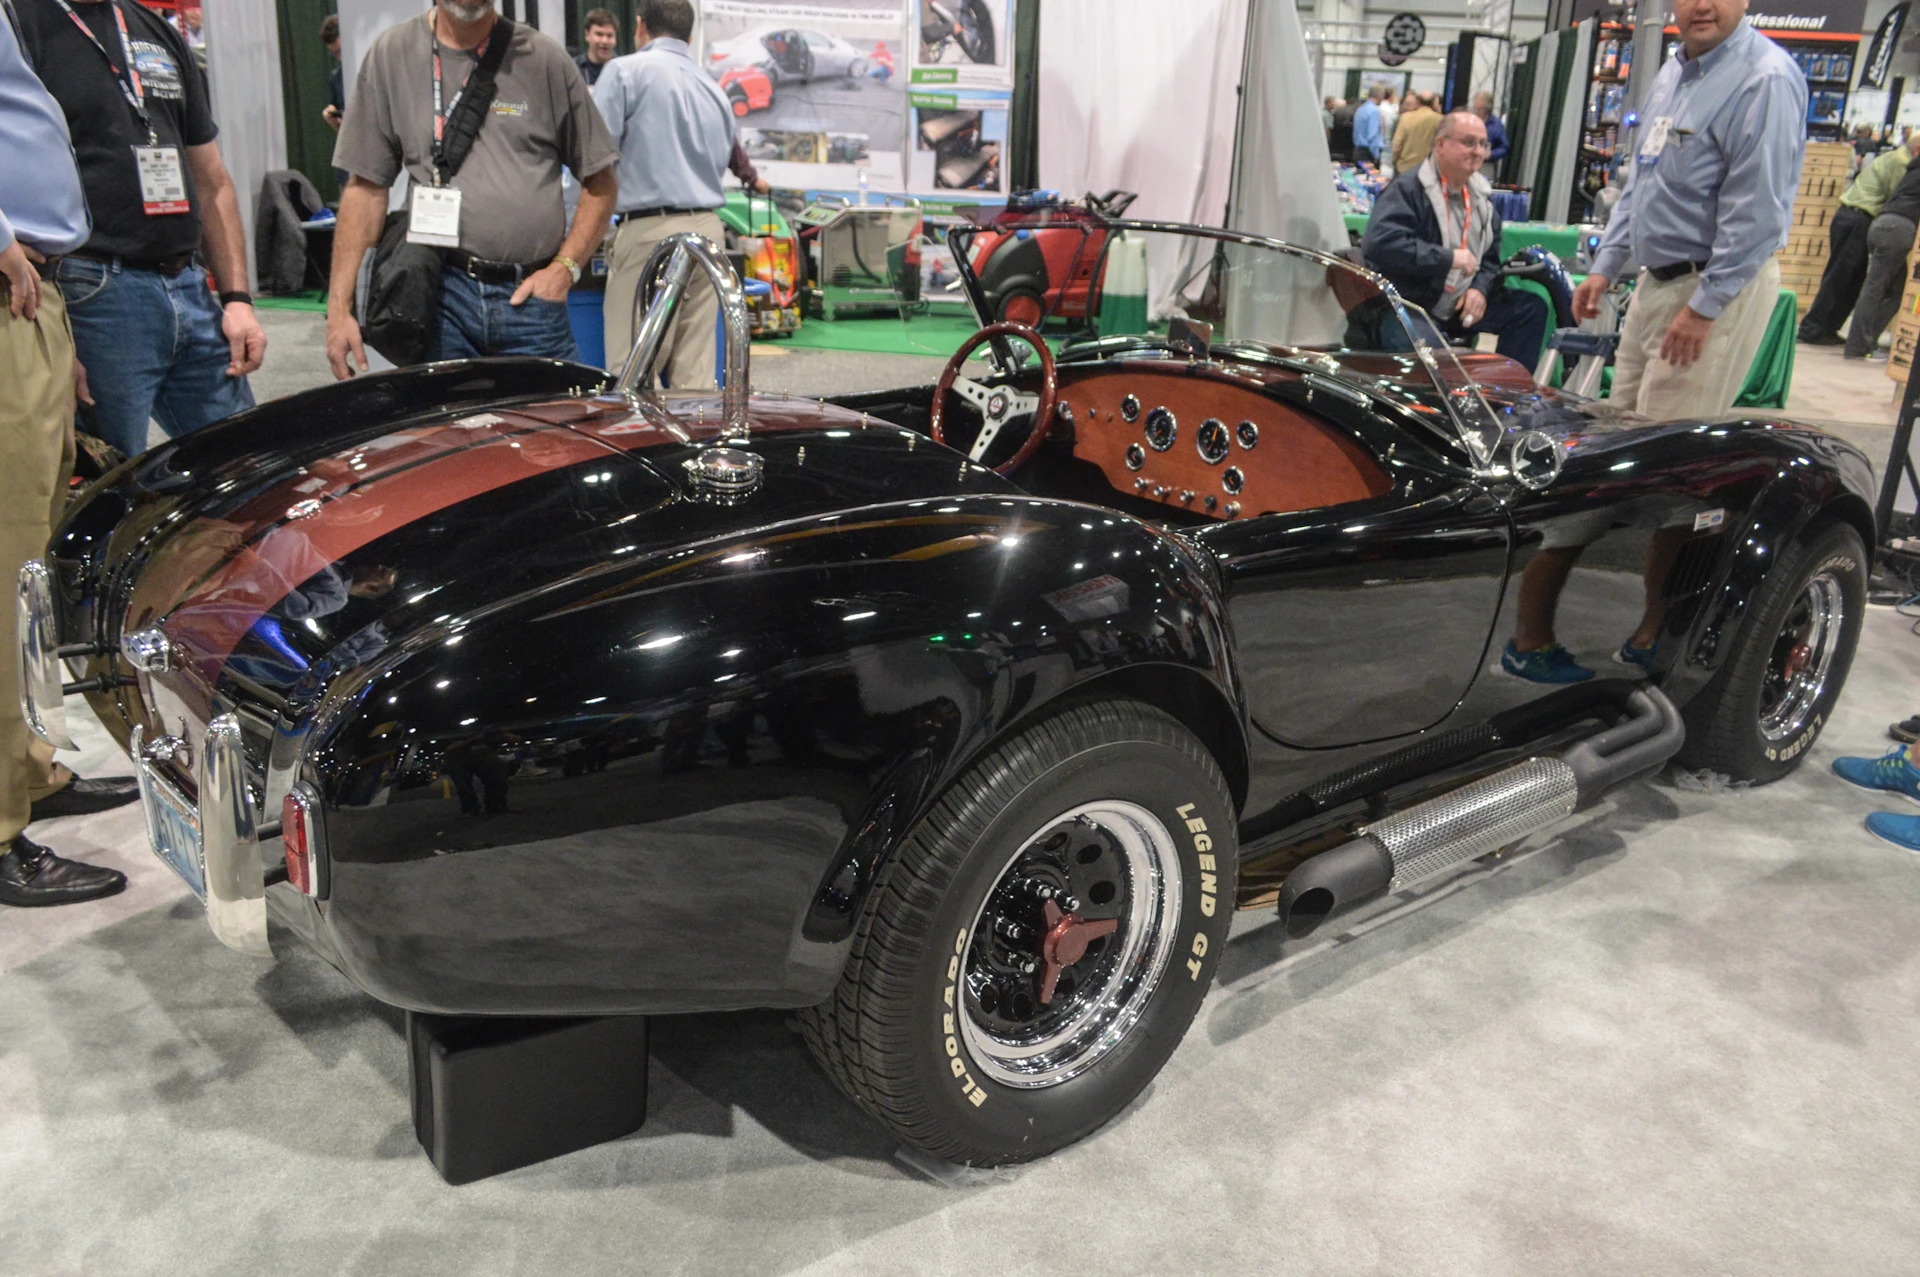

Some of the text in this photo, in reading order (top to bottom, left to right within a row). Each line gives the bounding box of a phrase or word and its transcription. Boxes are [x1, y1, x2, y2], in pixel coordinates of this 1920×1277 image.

[1745, 12, 1828, 30] ofessional
[1779, 712, 1823, 762] LEGEND
[1175, 802, 1218, 982] LEGEND GT
[943, 927, 988, 1108] ELDORADO
